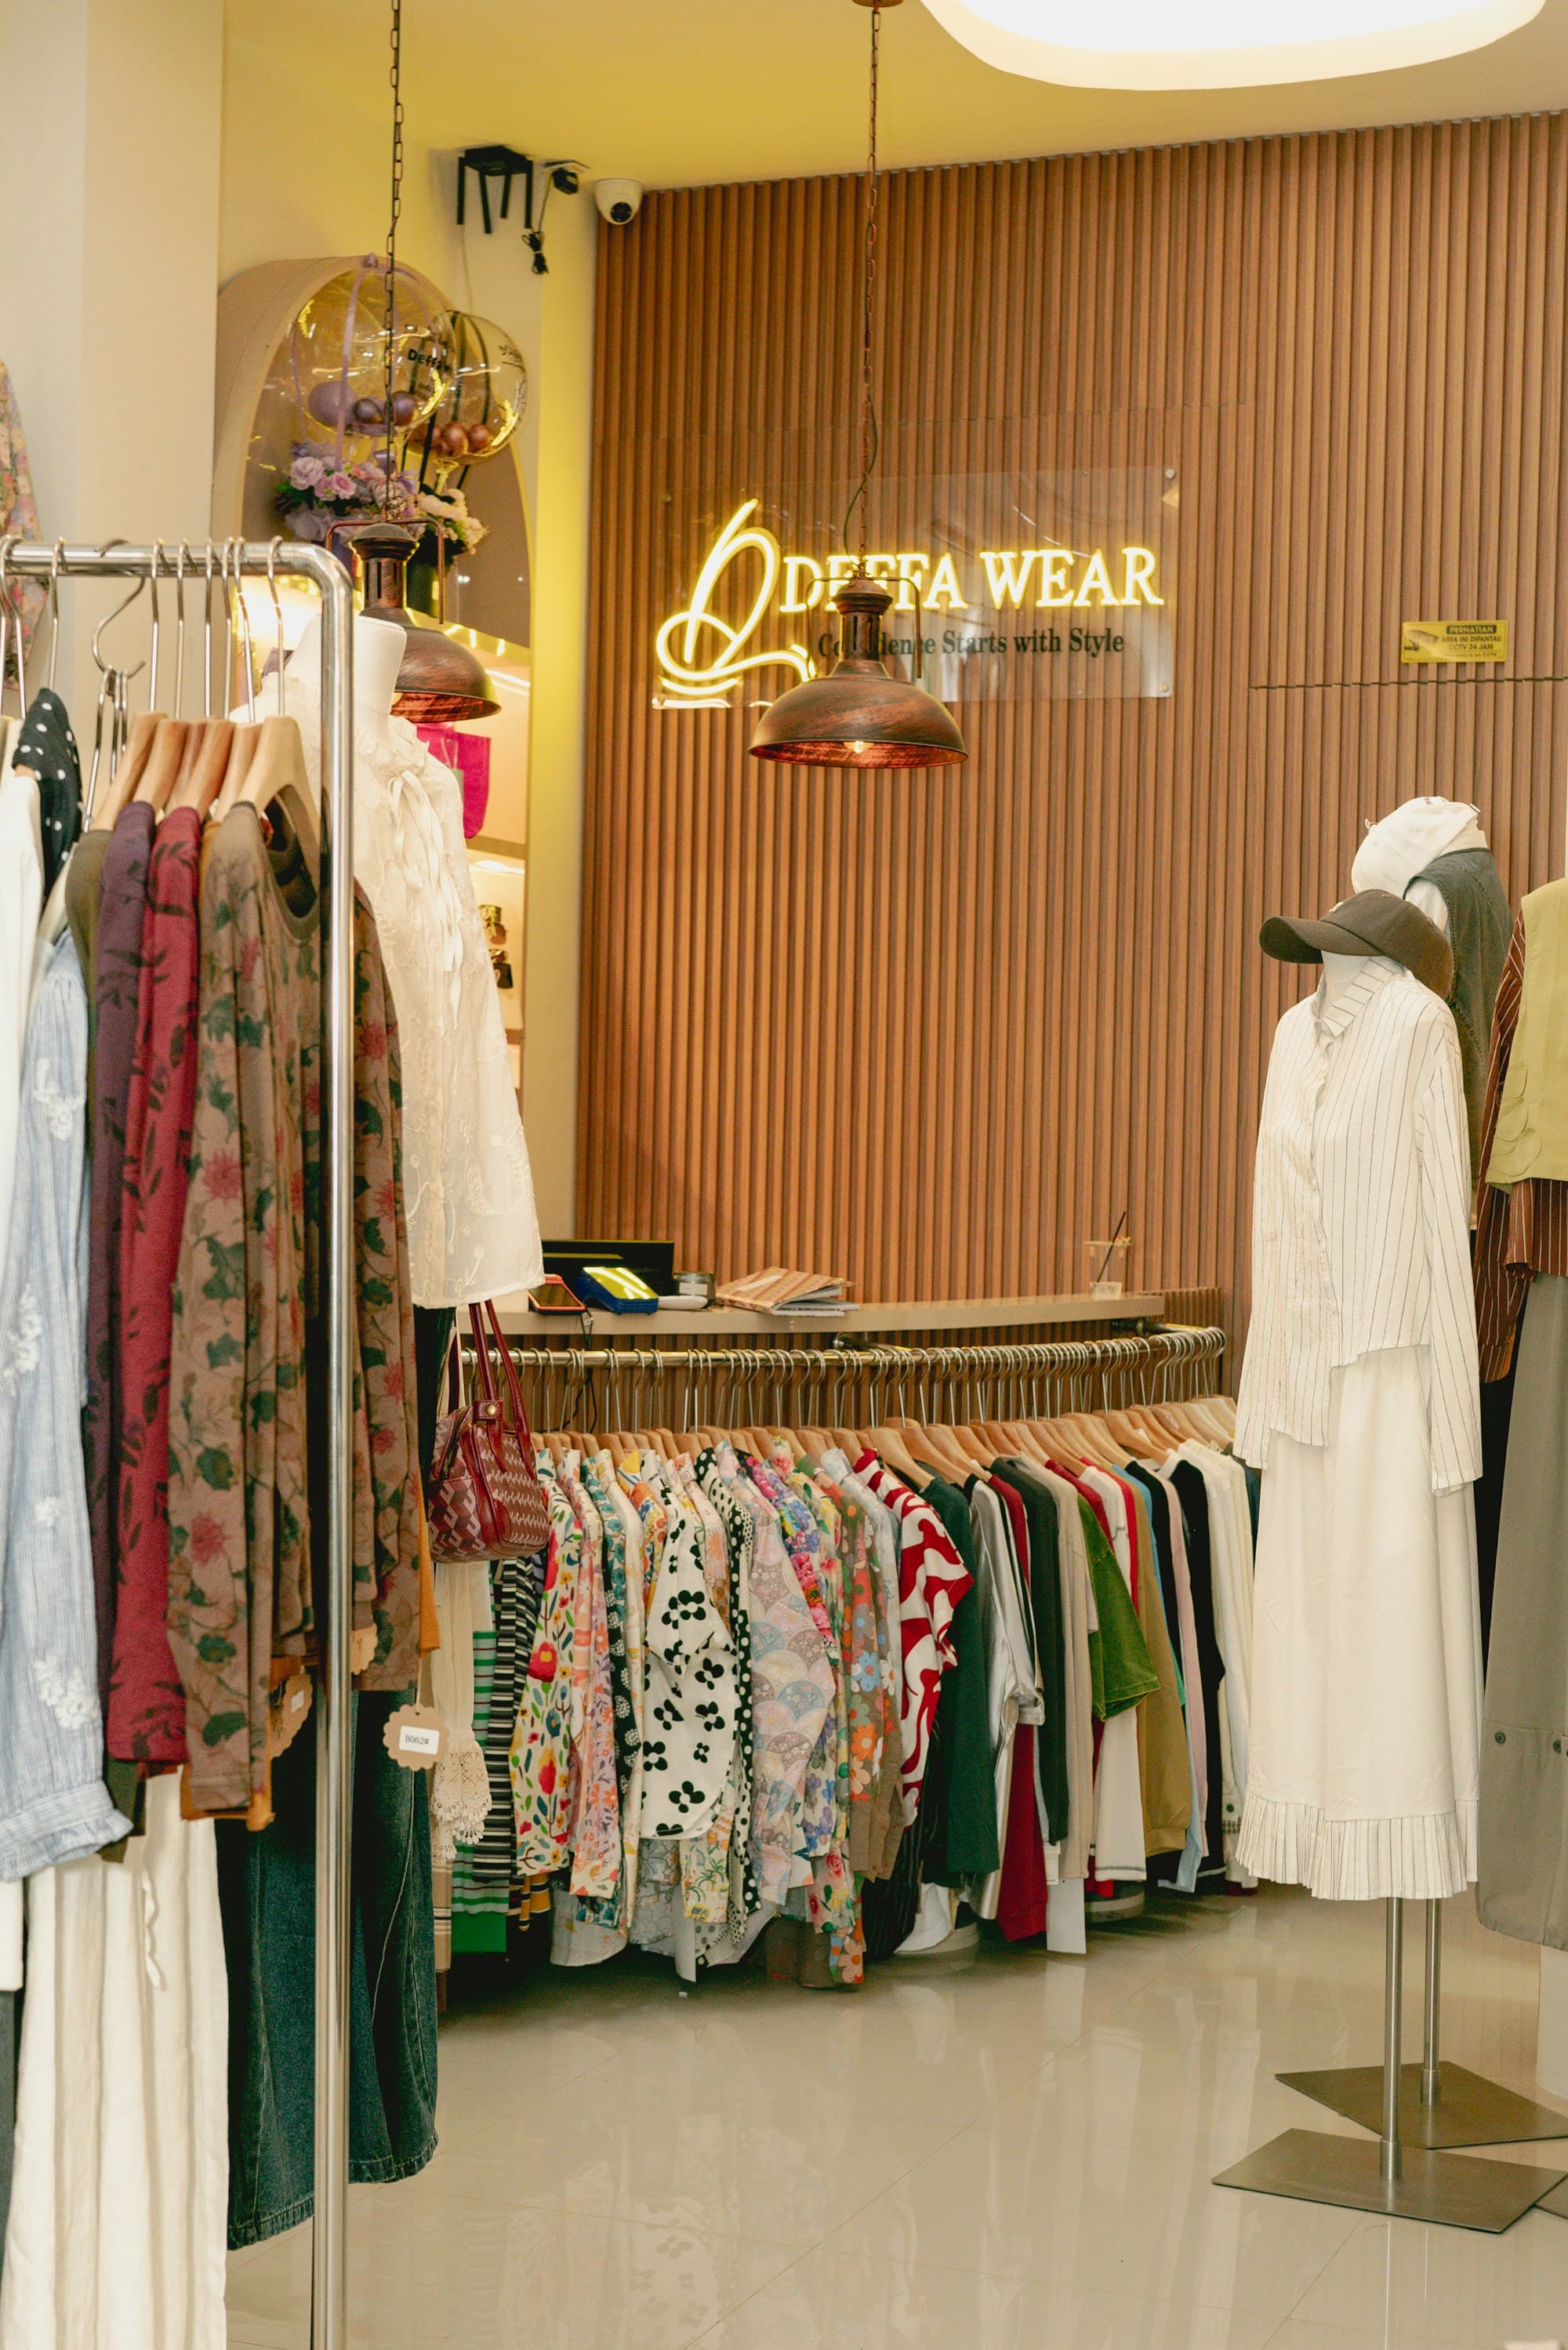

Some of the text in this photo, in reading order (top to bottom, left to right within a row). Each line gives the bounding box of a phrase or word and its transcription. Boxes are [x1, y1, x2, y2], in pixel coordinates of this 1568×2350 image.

[979, 547, 1165, 610] WEAR
[942, 629, 1007, 654] Starts
[1014, 627, 1062, 653] with
[1069, 627, 1124, 658] Style
